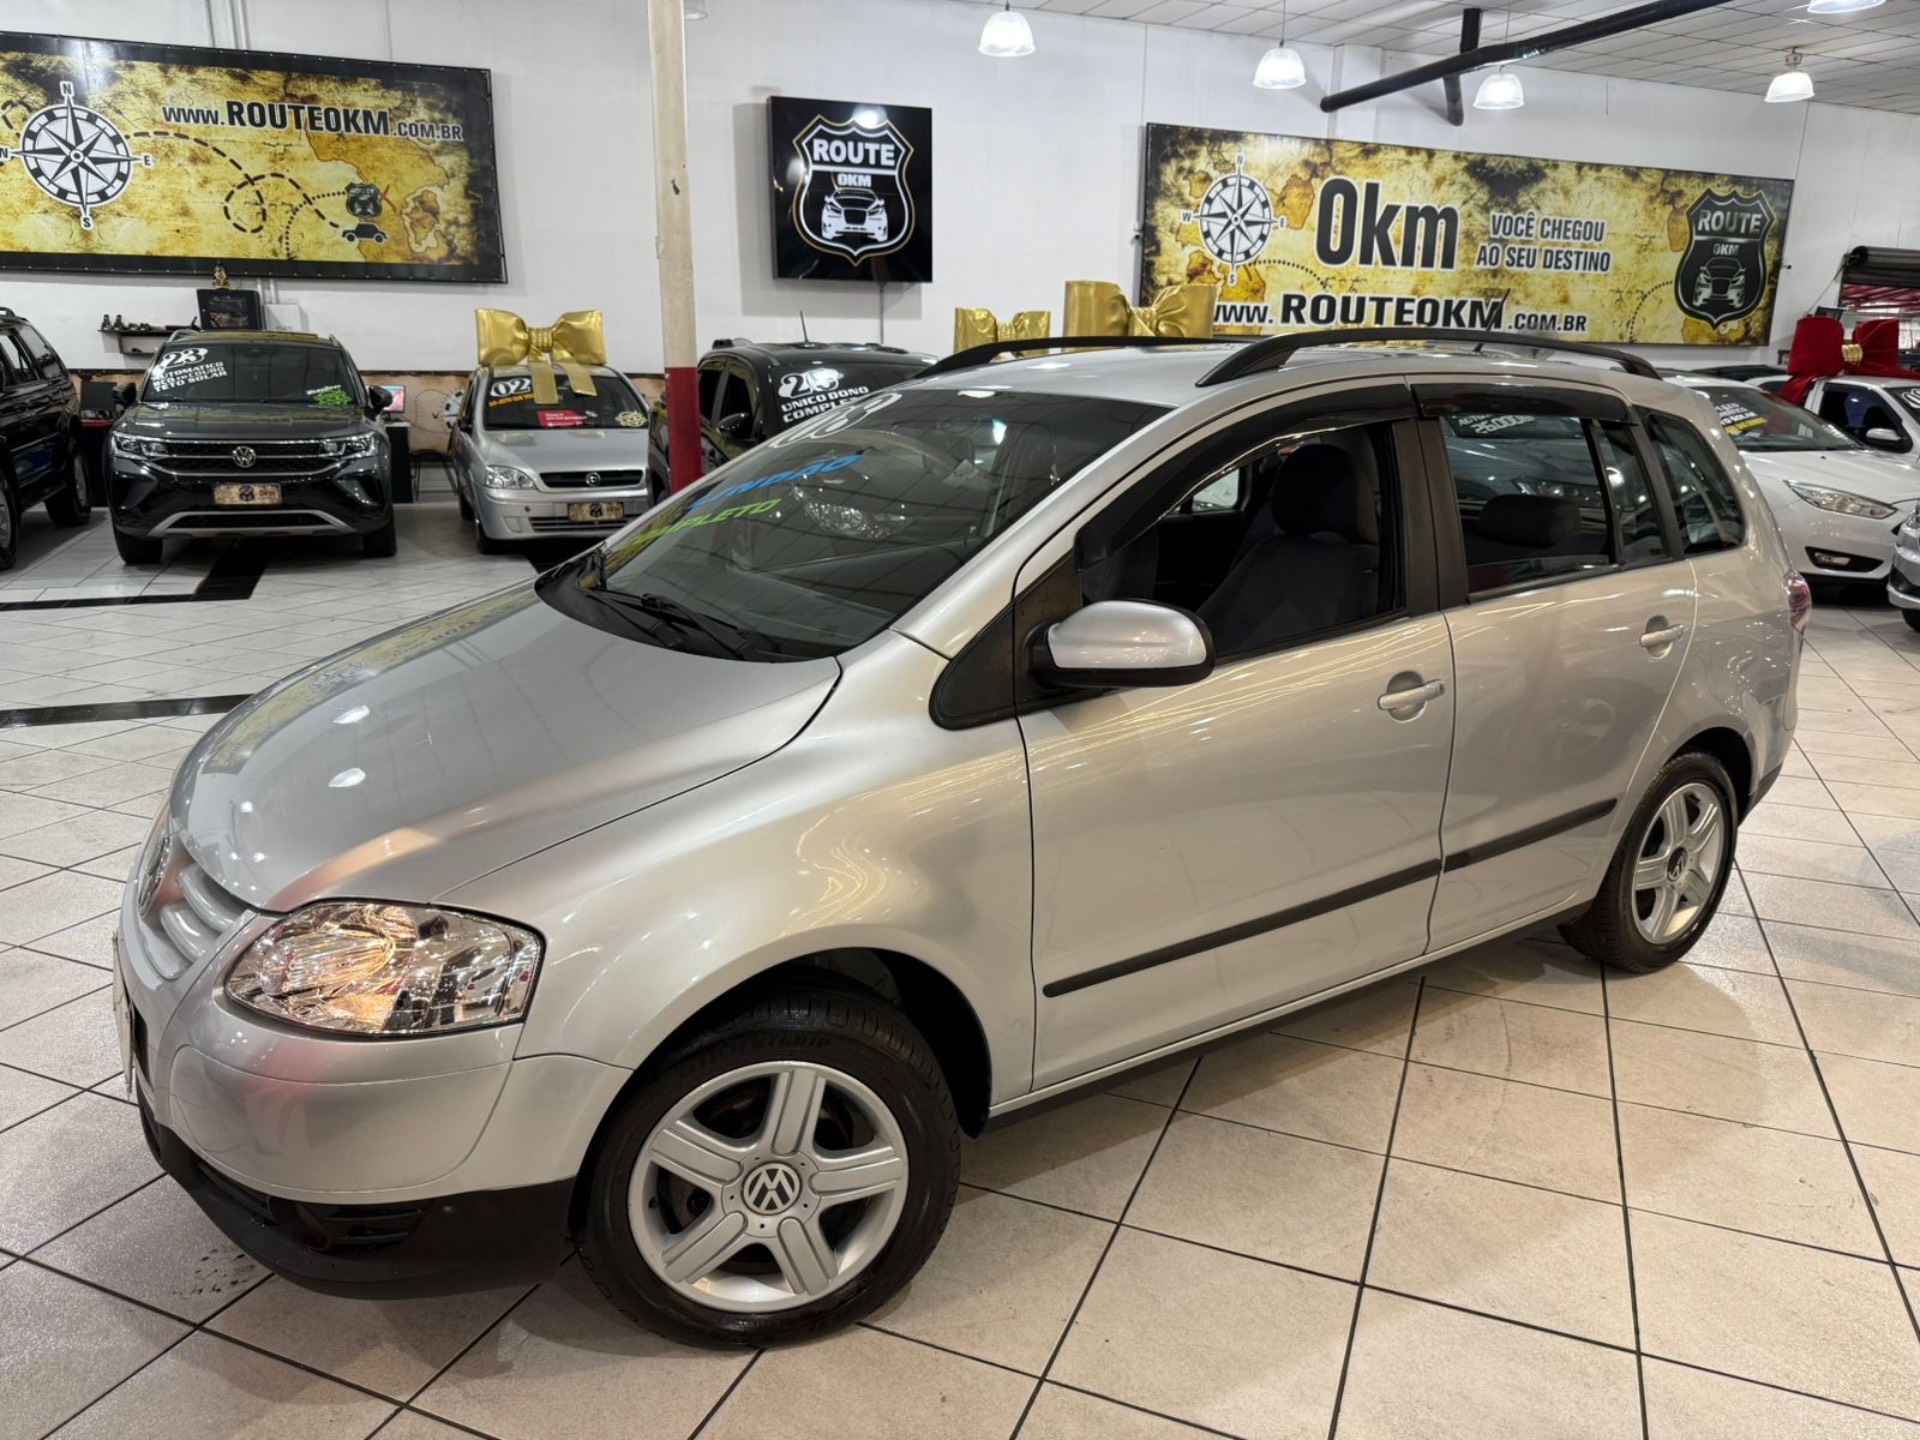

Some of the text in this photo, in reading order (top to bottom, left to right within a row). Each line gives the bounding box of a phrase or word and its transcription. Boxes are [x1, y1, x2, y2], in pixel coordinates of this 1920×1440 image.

[813, 139, 896, 167] ROUTE
[1491, 211, 1605, 242] VOCÊ CHEGOU
[1697, 209, 1763, 233] ROUTE
[1476, 245, 1611, 272] AO SEU DESTINO
[162, 347, 207, 369] 23
[491, 378, 531, 397] 02
[827, 386, 869, 400] DONO
